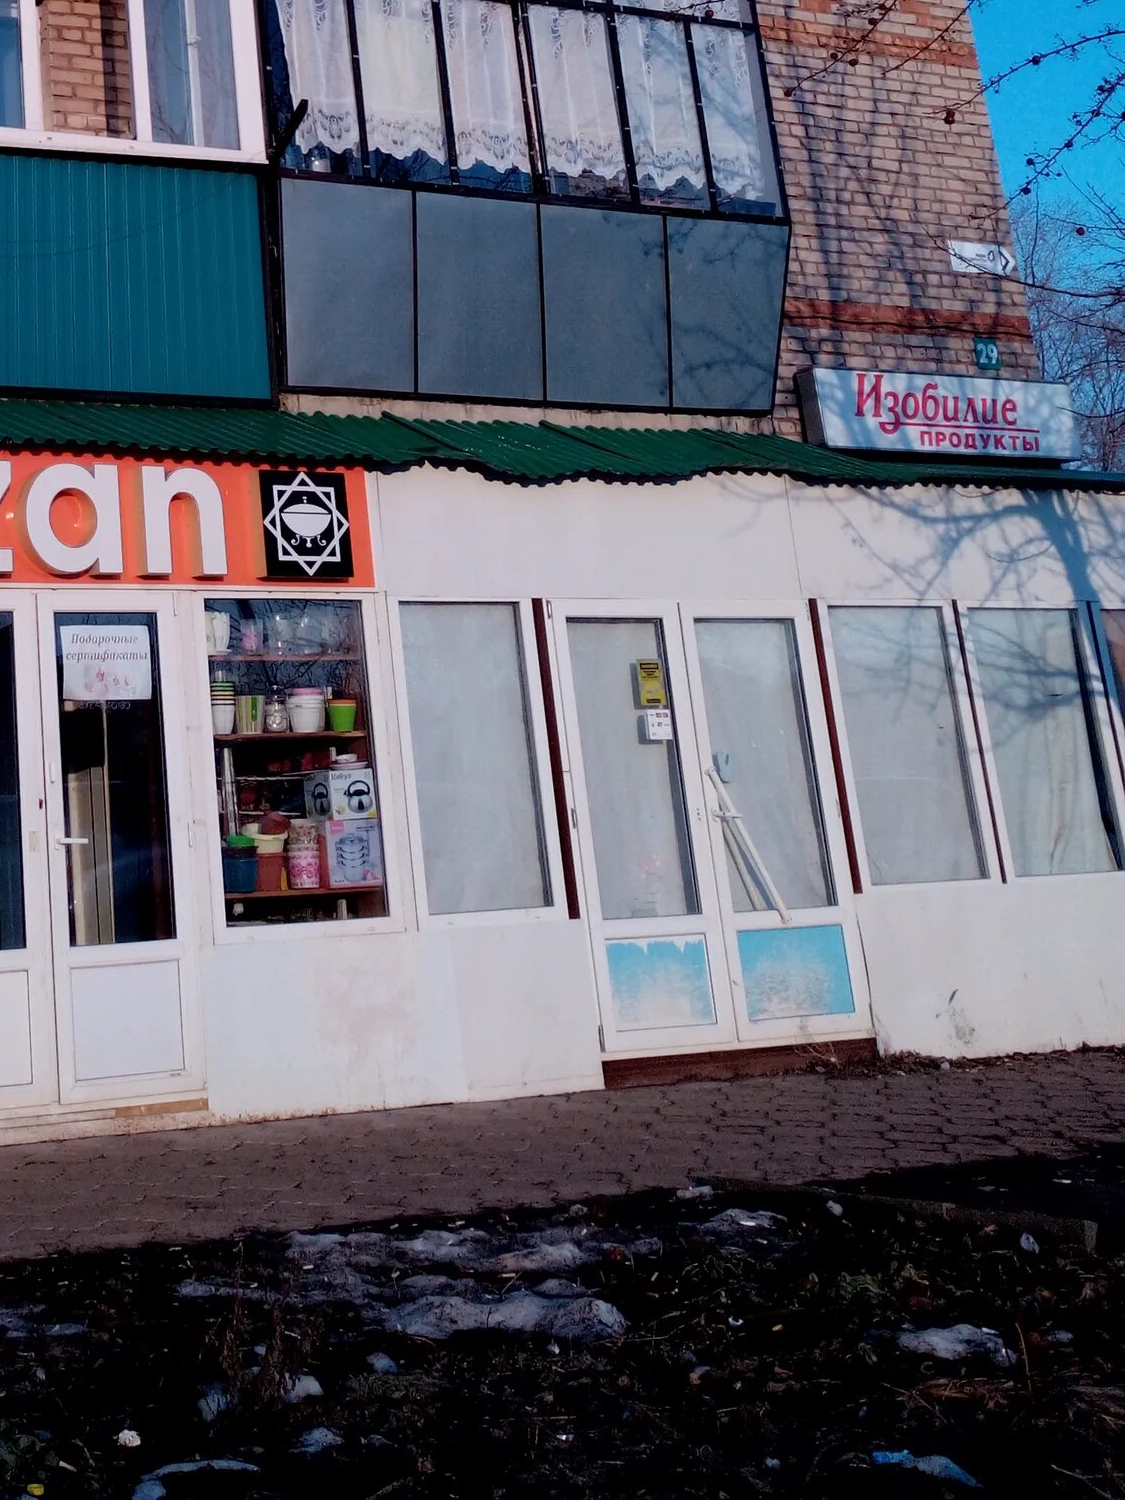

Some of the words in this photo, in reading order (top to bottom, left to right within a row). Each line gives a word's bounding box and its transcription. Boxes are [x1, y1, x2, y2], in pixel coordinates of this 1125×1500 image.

[976, 343, 999, 365] 29
[854, 372, 1018, 435] Изобилие
[919, 430, 1040, 453] ПРОДУКТЫ
[70, 633, 139, 647] Подарочные
[65, 650, 148, 663] сертификаты
